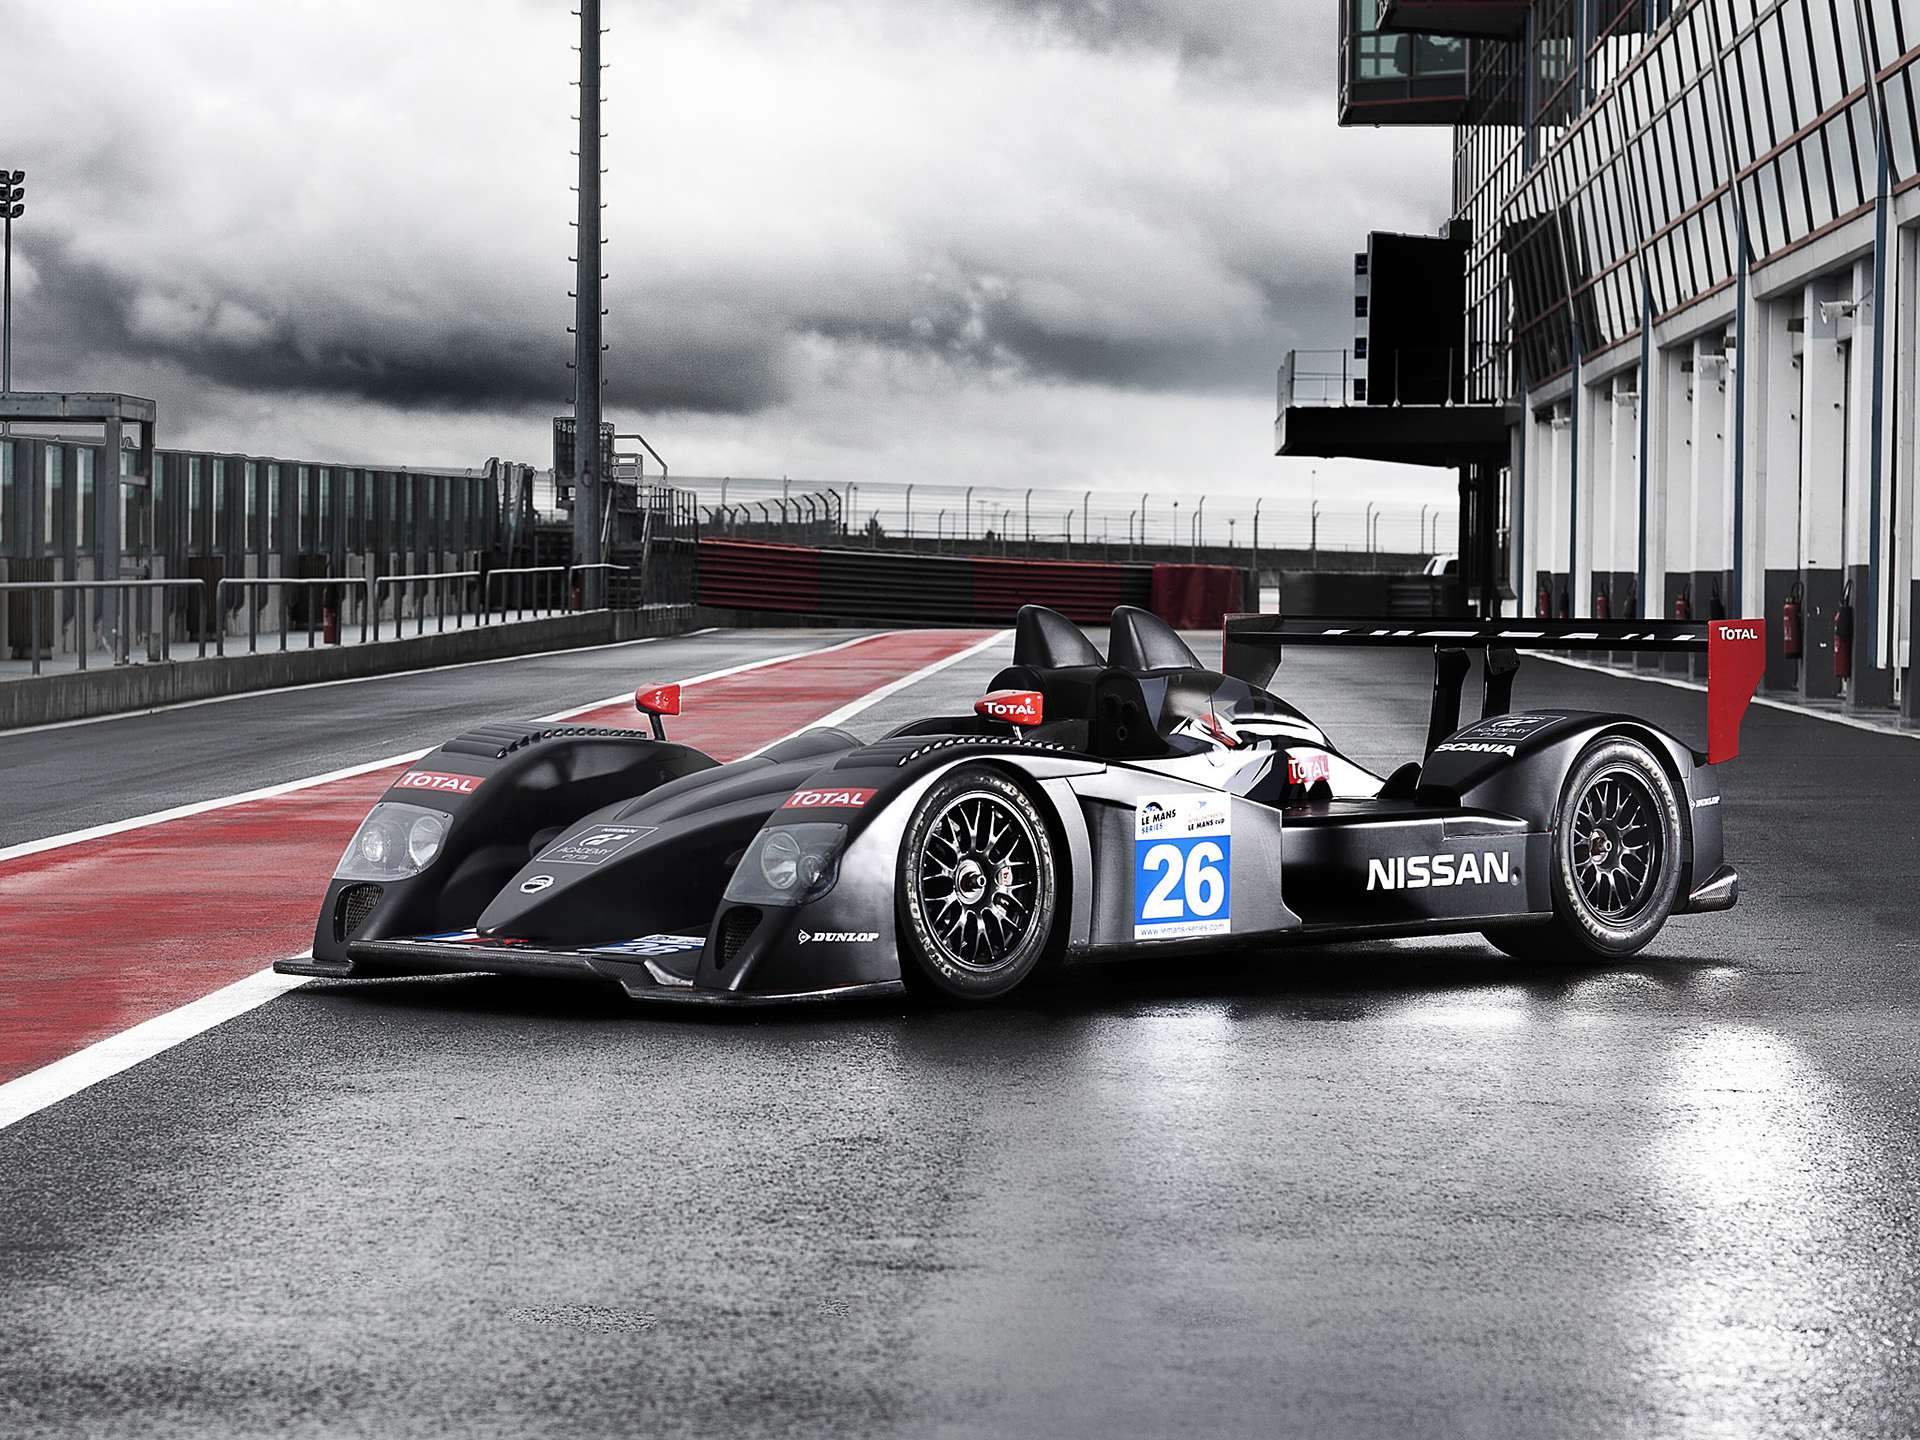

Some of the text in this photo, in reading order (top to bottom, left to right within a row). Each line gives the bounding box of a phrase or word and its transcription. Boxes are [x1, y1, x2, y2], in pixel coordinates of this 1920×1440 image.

[1718, 626, 1758, 640] TOTAL
[984, 702, 1035, 715] TOTAL
[1434, 743, 1517, 758] SCANIA
[1289, 758, 1329, 780] TOTAL
[403, 773, 473, 792] TOTAL
[791, 791, 865, 806] TOTAL
[1141, 809, 1177, 826] LE MANS
[1196, 819, 1214, 829] MANS
[1141, 823, 1163, 834] SERIES
[557, 847, 614, 855] ACADEMY
[1366, 851, 1509, 891] NISSAN
[1141, 841, 1225, 919] 26
[1561, 858, 1602, 939] DUNLOP
[811, 932, 880, 942] DUNLOP
[1140, 923, 1225, 936] www.lemans-series.com
